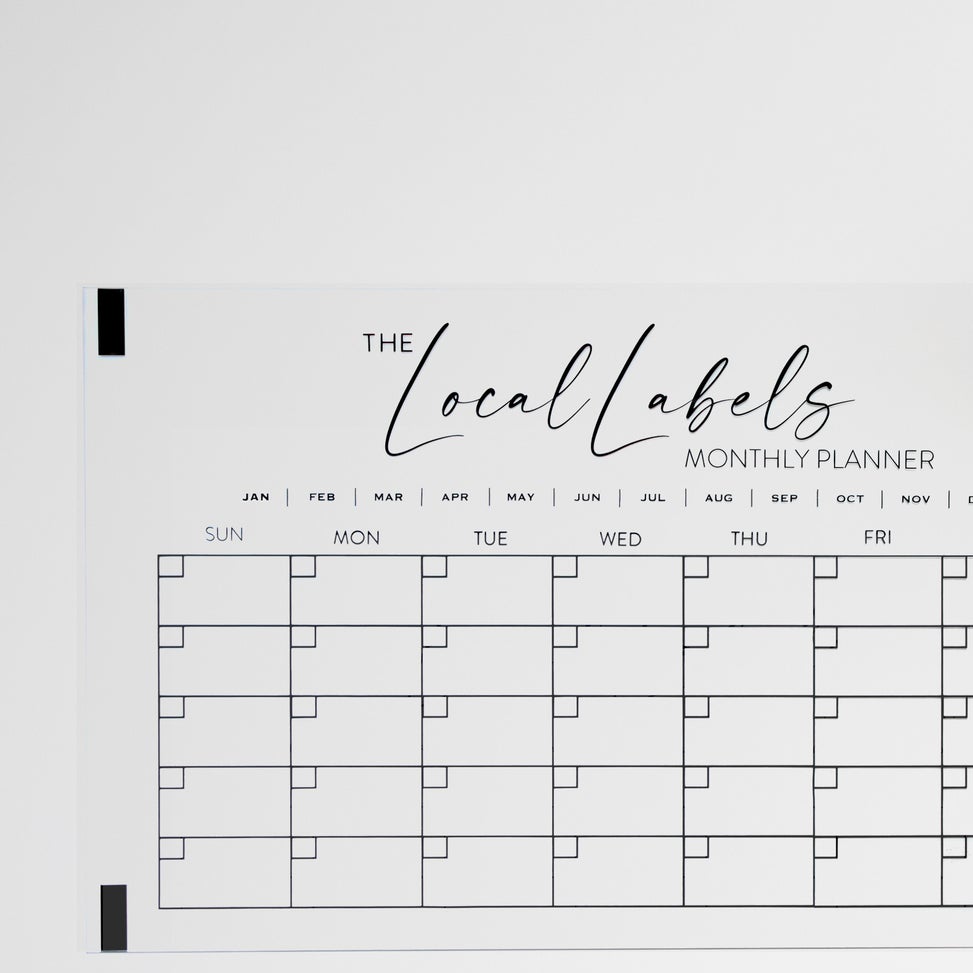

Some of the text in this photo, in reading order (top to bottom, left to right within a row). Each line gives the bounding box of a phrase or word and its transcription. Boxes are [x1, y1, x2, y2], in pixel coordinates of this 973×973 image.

[361, 332, 414, 354] THE
[384, 321, 856, 458] Local Labels
[684, 447, 935, 472] MONTHLY PLANNER
[241, 492, 270, 502] JAN
[308, 492, 336, 502] FEB
[373, 492, 404, 502] MAR
[441, 492, 469, 502] APR
[506, 492, 535, 502] MAY
[573, 492, 601, 502] JUN
[640, 492, 667, 503] JUL
[704, 493, 733, 503] AUG
[771, 493, 799, 504] SEP
[836, 494, 865, 504] OCT
[901, 494, 931, 505] NOV
[204, 526, 244, 542] SUN
[333, 529, 380, 546] MON
[473, 530, 509, 547] TUE
[599, 531, 643, 548] WED
[730, 530, 768, 547] THU
[864, 529, 892, 545] FRI
